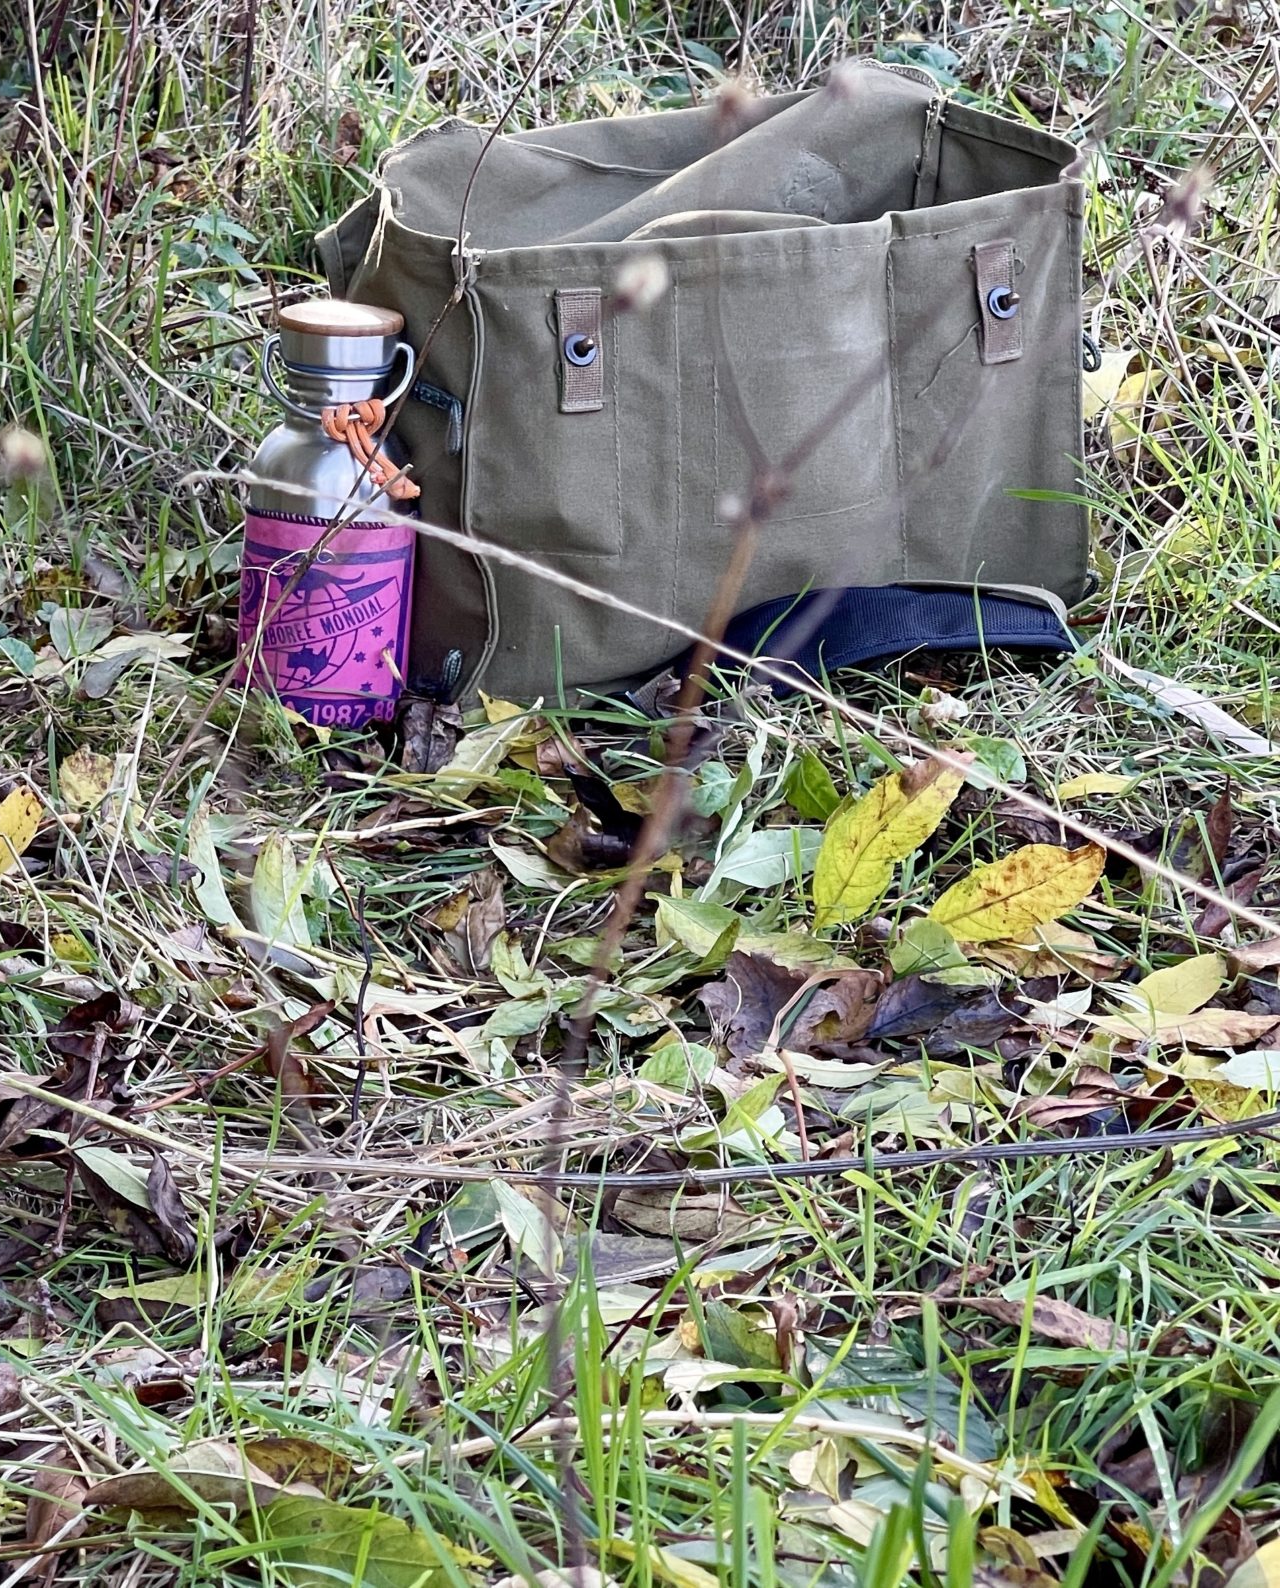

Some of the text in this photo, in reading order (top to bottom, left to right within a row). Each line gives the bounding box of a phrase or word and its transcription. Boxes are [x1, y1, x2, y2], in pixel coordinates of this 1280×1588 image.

[242, 596, 385, 648] JBOREE MONDIAL
[312, 701, 395, 727] 1987-88
